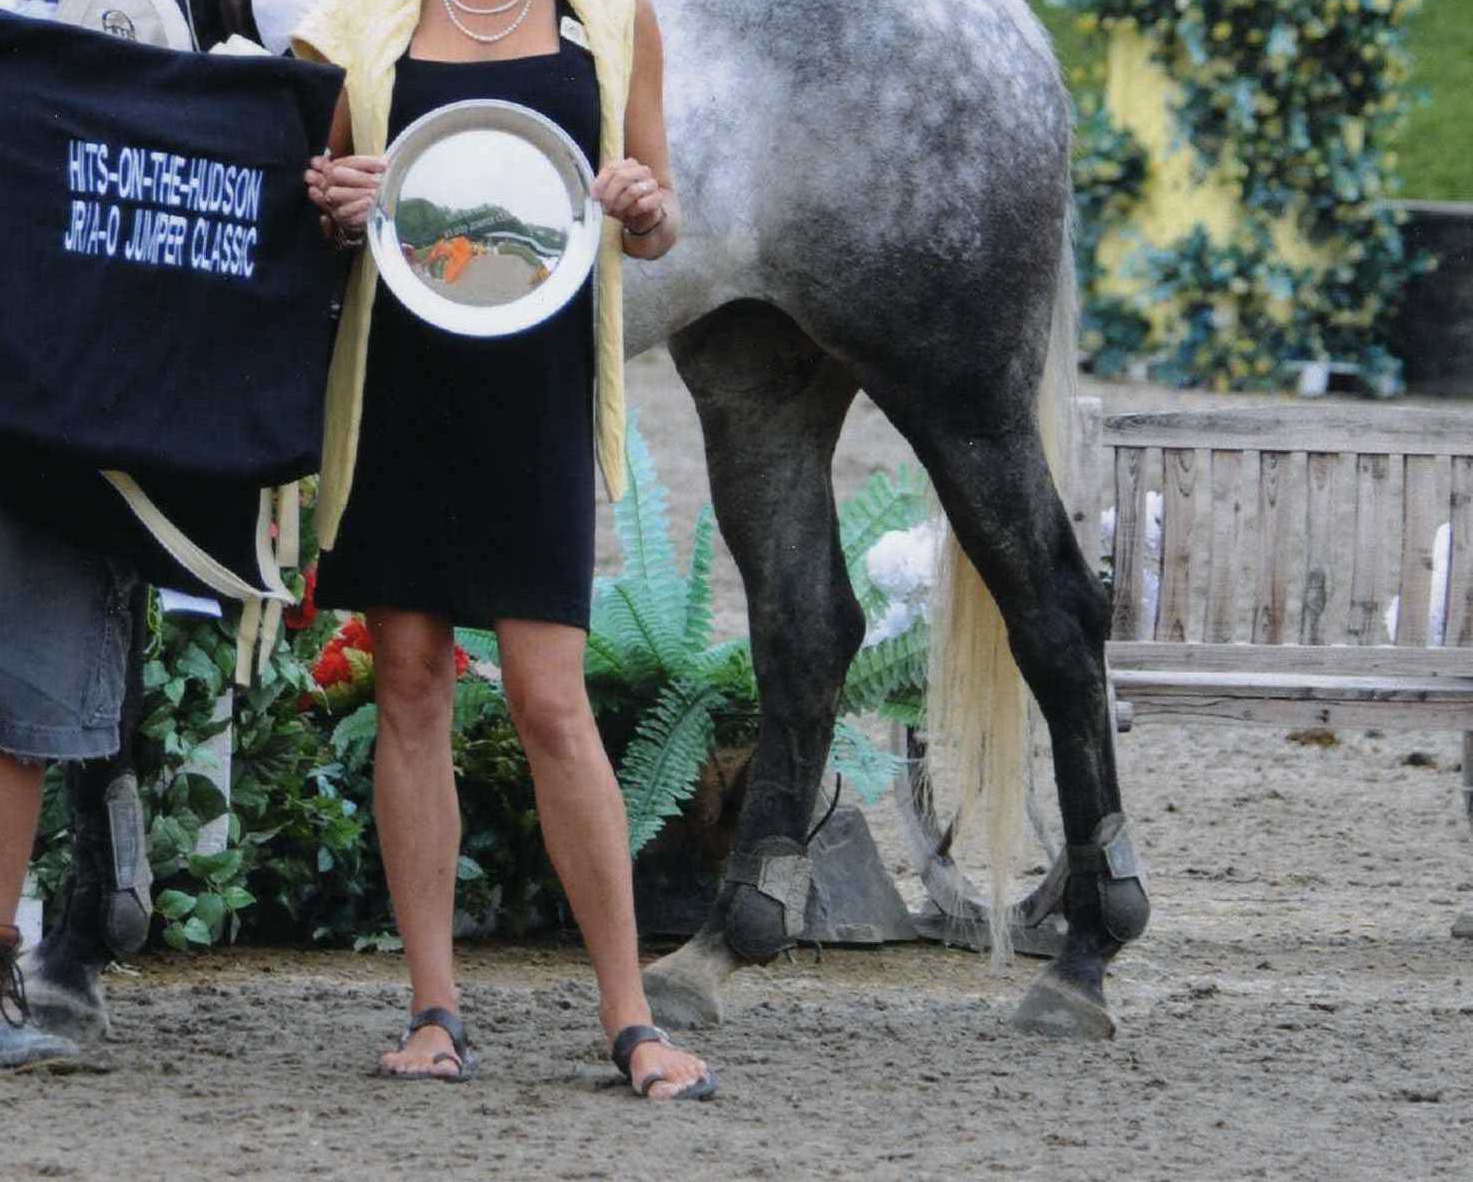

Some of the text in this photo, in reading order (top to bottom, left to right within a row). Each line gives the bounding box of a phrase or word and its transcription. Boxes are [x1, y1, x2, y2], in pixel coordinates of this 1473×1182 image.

[68, 139, 263, 221] HITS-ON-THE-HUDSON
[125, 209, 187, 266] JUMPER
[190, 218, 257, 277] CLASSIC
